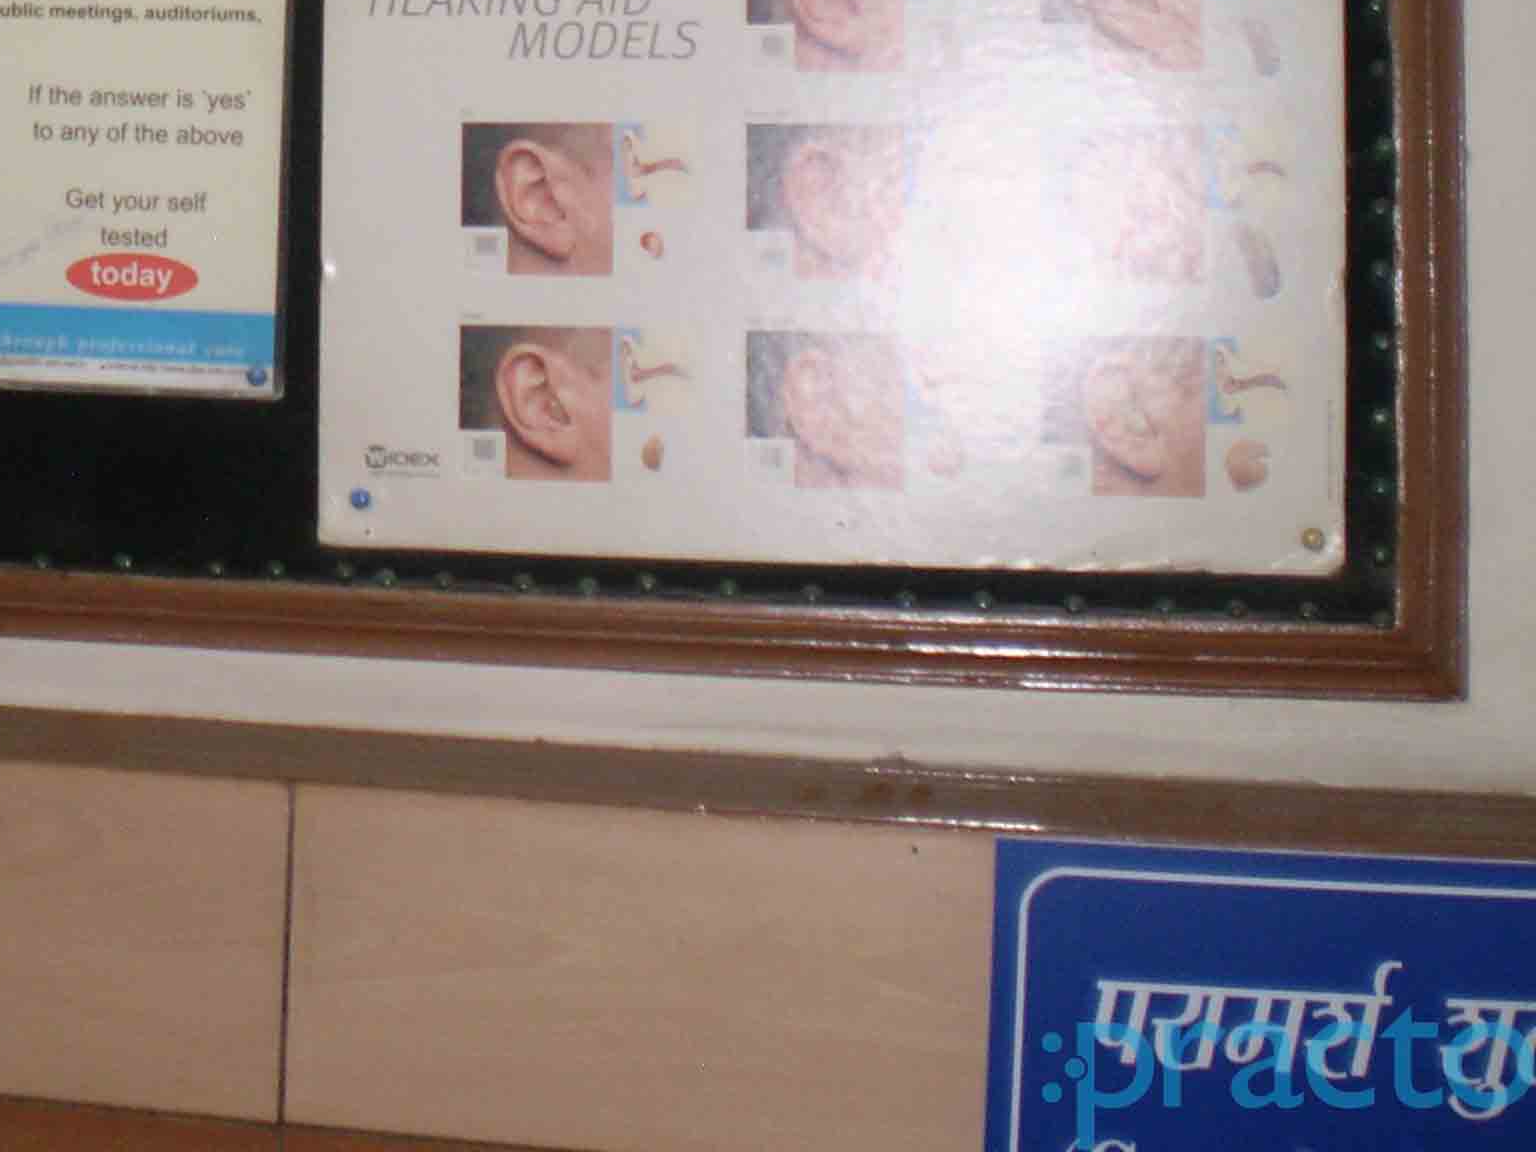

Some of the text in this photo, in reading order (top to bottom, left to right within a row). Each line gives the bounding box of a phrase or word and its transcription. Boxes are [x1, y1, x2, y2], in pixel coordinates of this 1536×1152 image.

[144, 5, 262, 23] auditoriums,
[508, 21, 701, 60] MODELS
[29, 86, 43, 106] If
[48, 86, 82, 107] the
[89, 92, 169, 108] answer
[177, 88, 192, 109] is
[33, 123, 242, 147] to any of the above
[66, 189, 207, 214] Get your self
[101, 228, 168, 247] tested
[90, 259, 173, 291] today
[1097, 960, 1536, 1120] परामर्श शु
